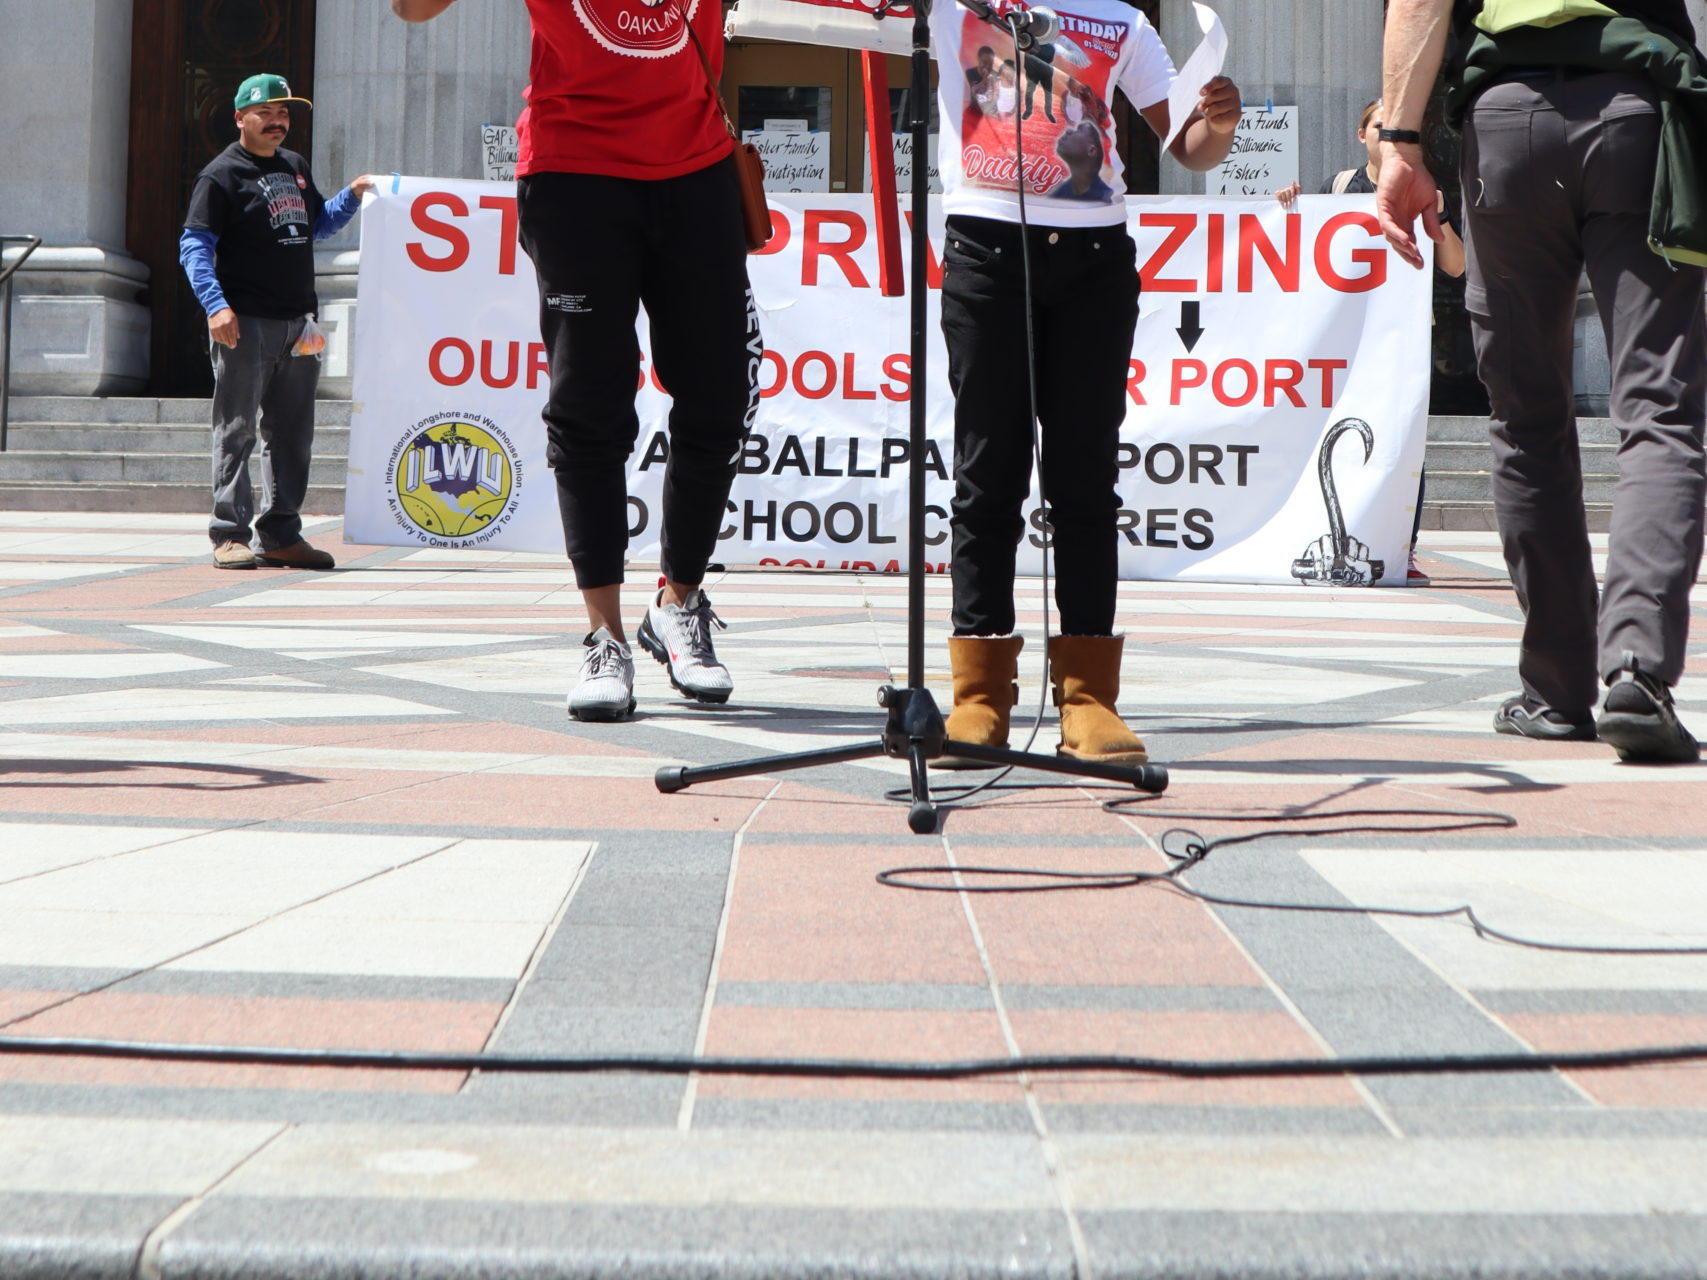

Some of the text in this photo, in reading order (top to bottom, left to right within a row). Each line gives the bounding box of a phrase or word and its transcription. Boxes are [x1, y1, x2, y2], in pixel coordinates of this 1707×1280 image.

[1057, 14, 1127, 43] RTHDAY
[484, 129, 507, 146] GAP
[1255, 111, 1289, 130] Funds
[784, 134, 820, 159] Family
[963, 144, 1064, 195] Daddy
[1221, 160, 1270, 180] Fisher's
[406, 192, 519, 275] ST
[428, 337, 550, 389] OUR
[1170, 358, 1347, 408] PORT
[385, 411, 523, 488] International Longshore and Warehouse Union
[406, 443, 503, 496] ILWU
[738, 434, 957, 480] BALLPA
[387, 498, 519, 548] An Injury To One Is An Injury To All
[718, 499, 897, 544] CHOOL
